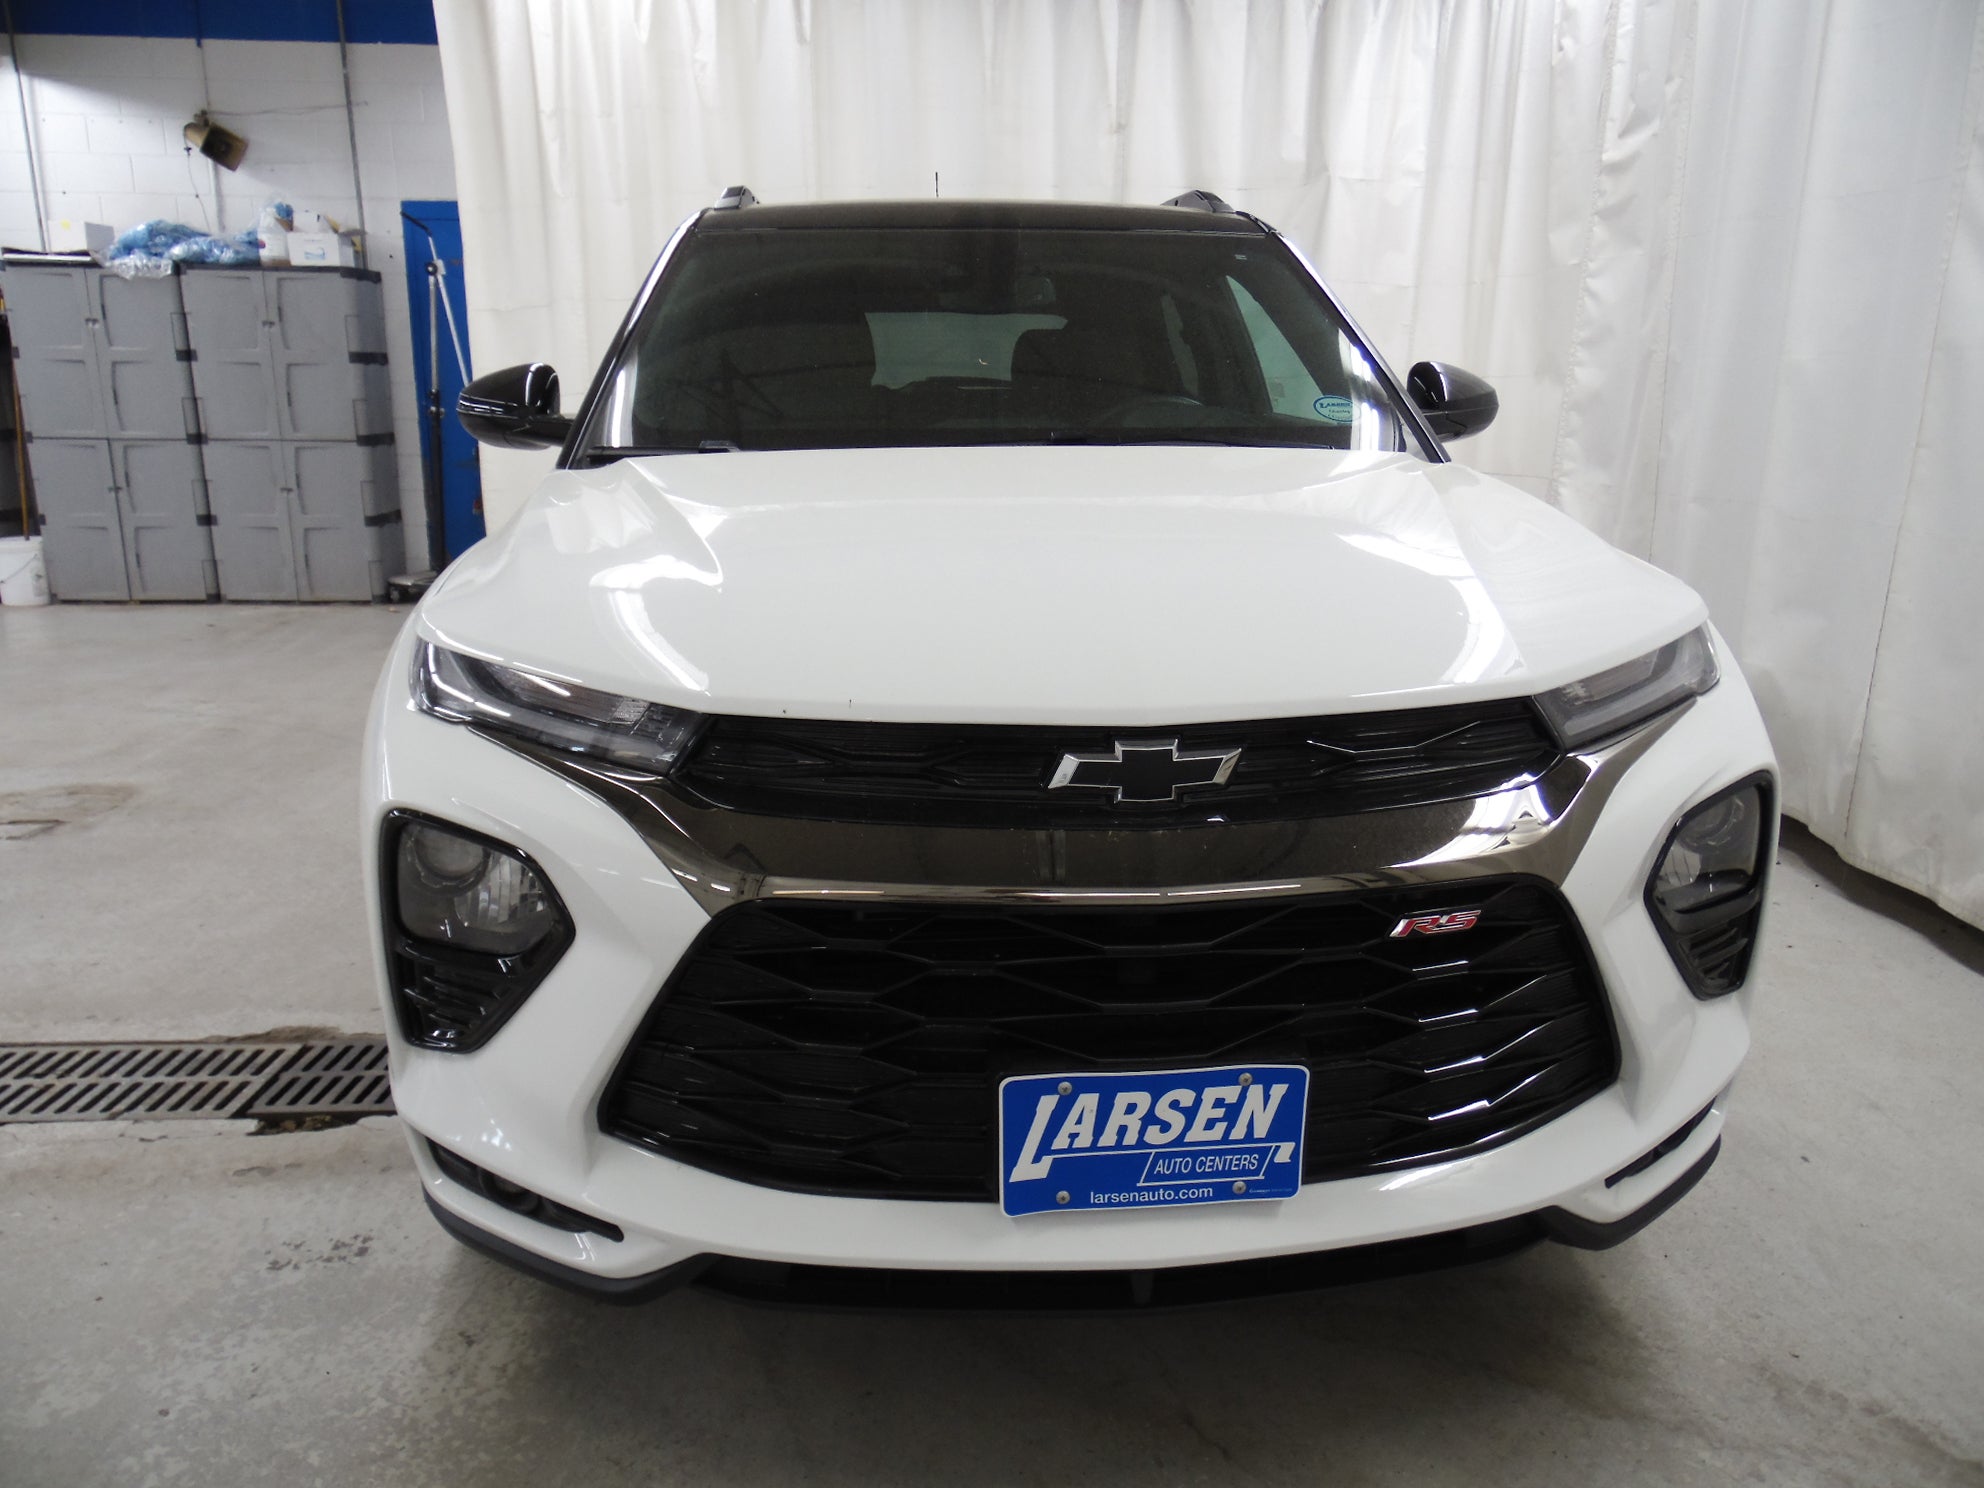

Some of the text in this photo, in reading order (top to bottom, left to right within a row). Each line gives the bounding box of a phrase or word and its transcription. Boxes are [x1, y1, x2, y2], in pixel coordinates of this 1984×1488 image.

[1389, 909, 1481, 938] RS
[1008, 1083, 1290, 1183] LARSEN
[1153, 1153, 1259, 1175] AUTO CENTERS
[1089, 1185, 1214, 1204] larsenauto.com
